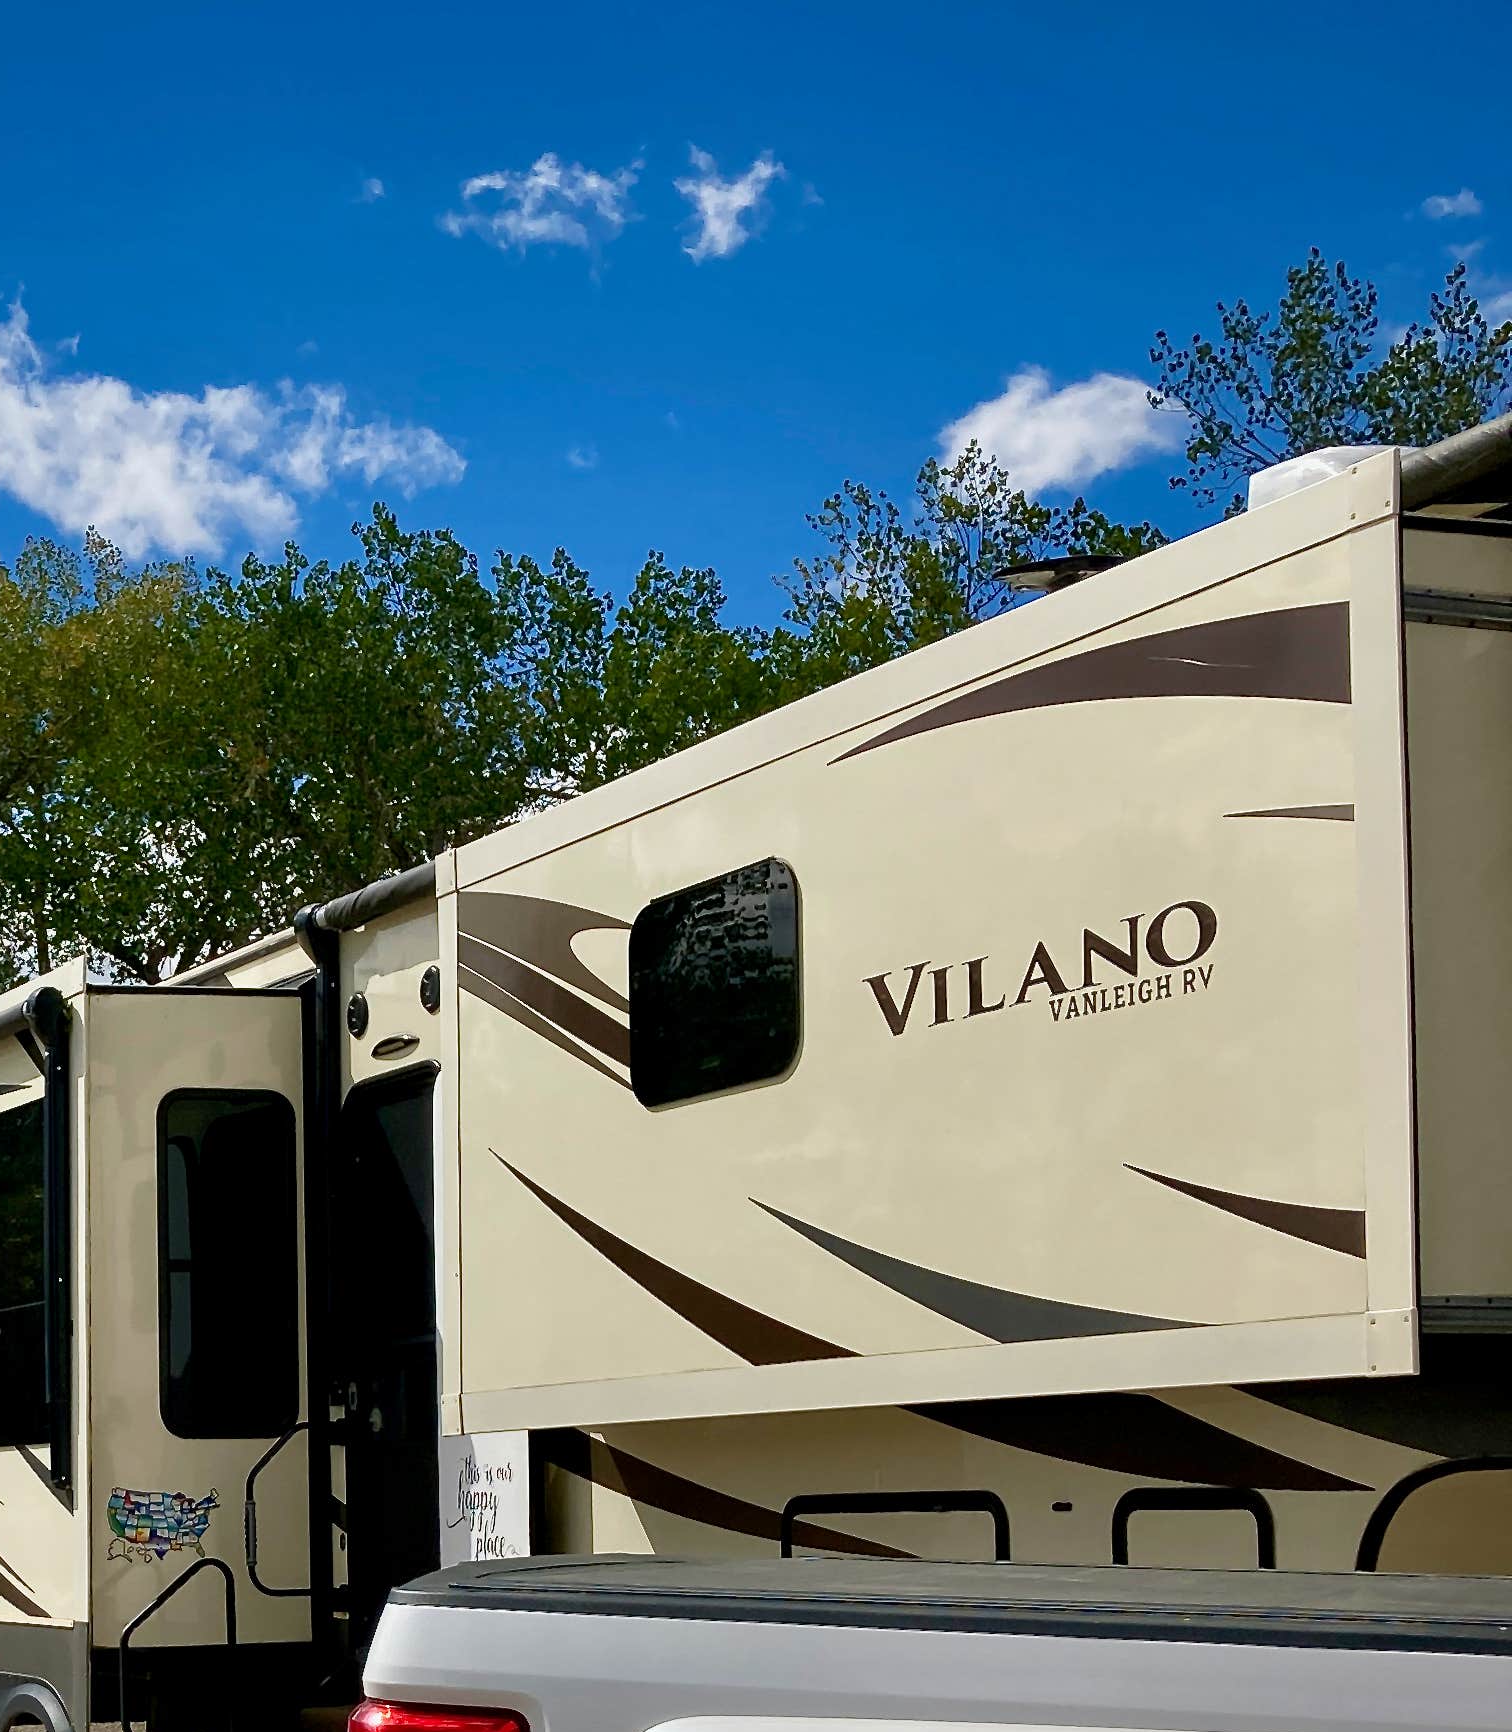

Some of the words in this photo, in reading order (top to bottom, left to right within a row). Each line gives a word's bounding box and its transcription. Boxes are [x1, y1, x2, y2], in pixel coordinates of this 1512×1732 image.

[862, 900, 1217, 1037] VILANO
[1048, 973, 1173, 1022] VANLEIGH
[1183, 963, 1215, 995] RV
[447, 1469, 499, 1533] happy
[484, 1463, 493, 1485] is
[496, 1461, 512, 1482] our
[474, 1519, 506, 1563] place
